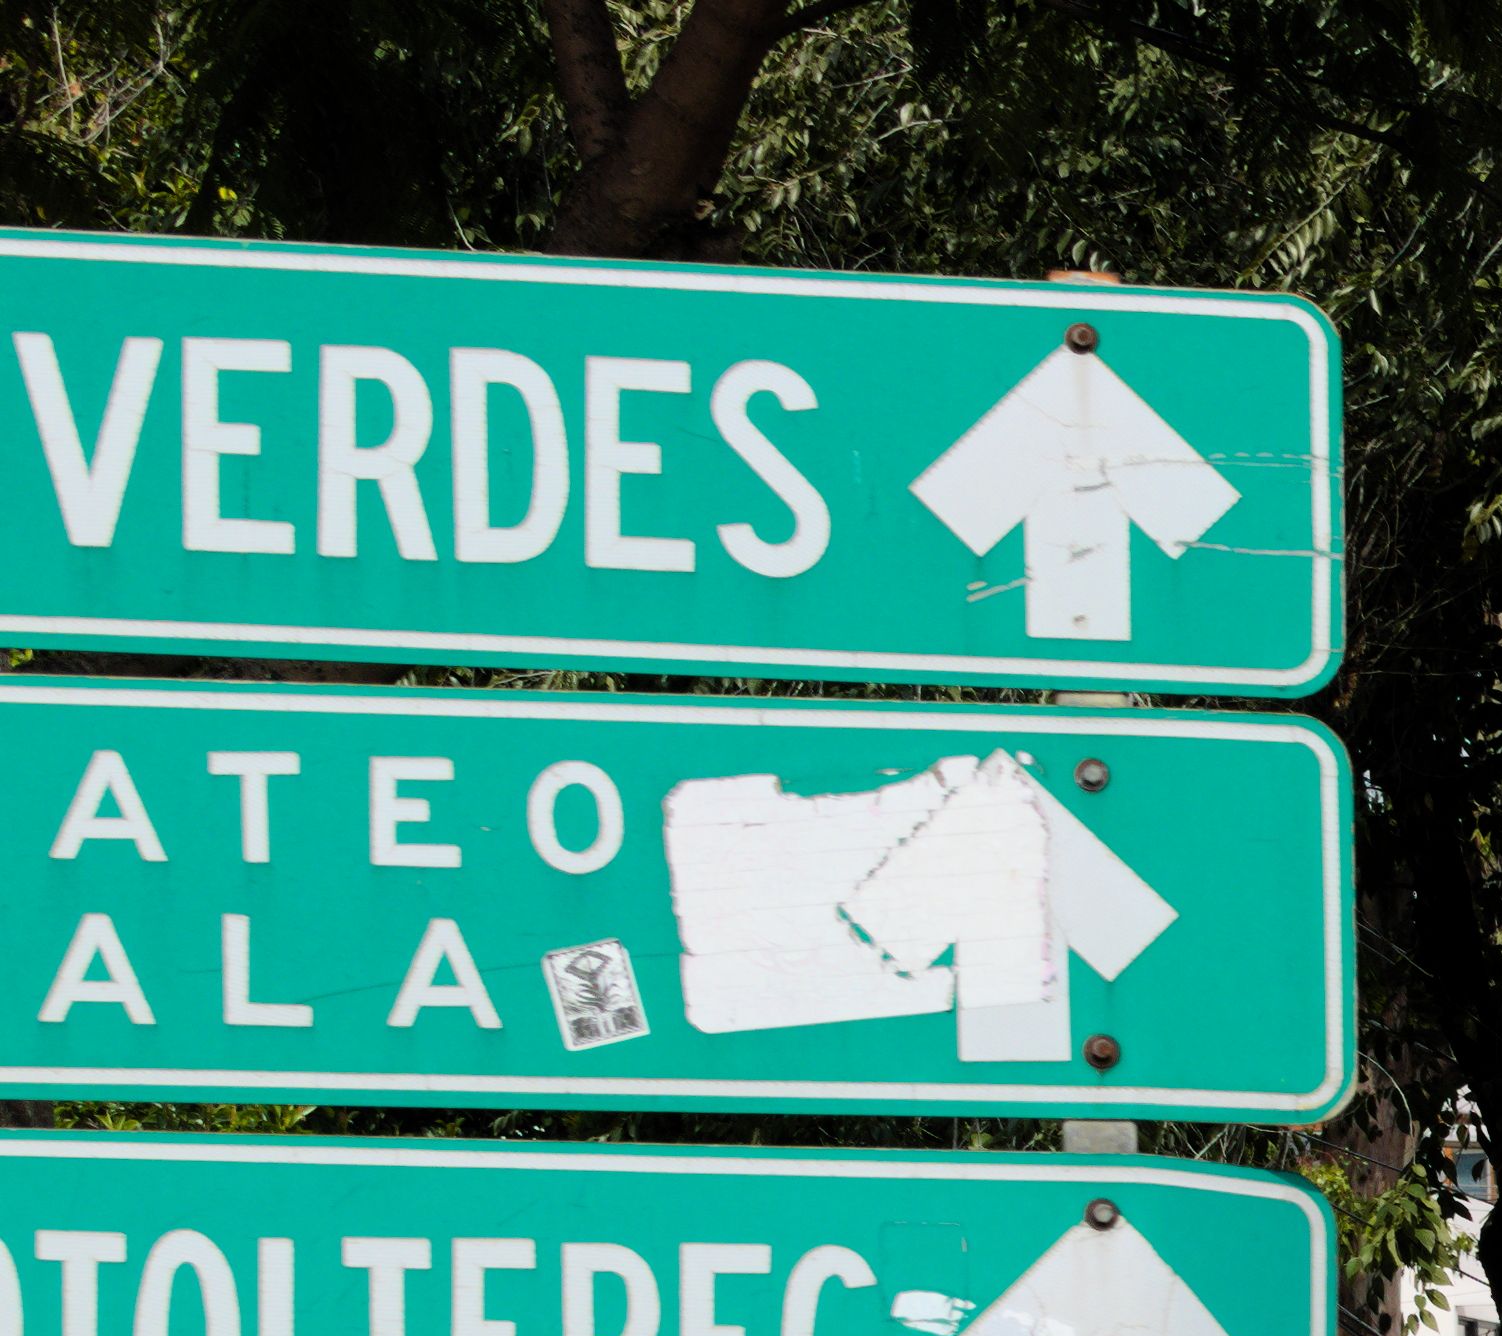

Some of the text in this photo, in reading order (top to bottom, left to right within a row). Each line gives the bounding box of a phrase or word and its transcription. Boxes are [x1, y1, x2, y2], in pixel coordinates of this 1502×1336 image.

[13, 332, 831, 578] VERDES
[49, 750, 623, 874] ATEO
[37, 913, 502, 1029] ALA
